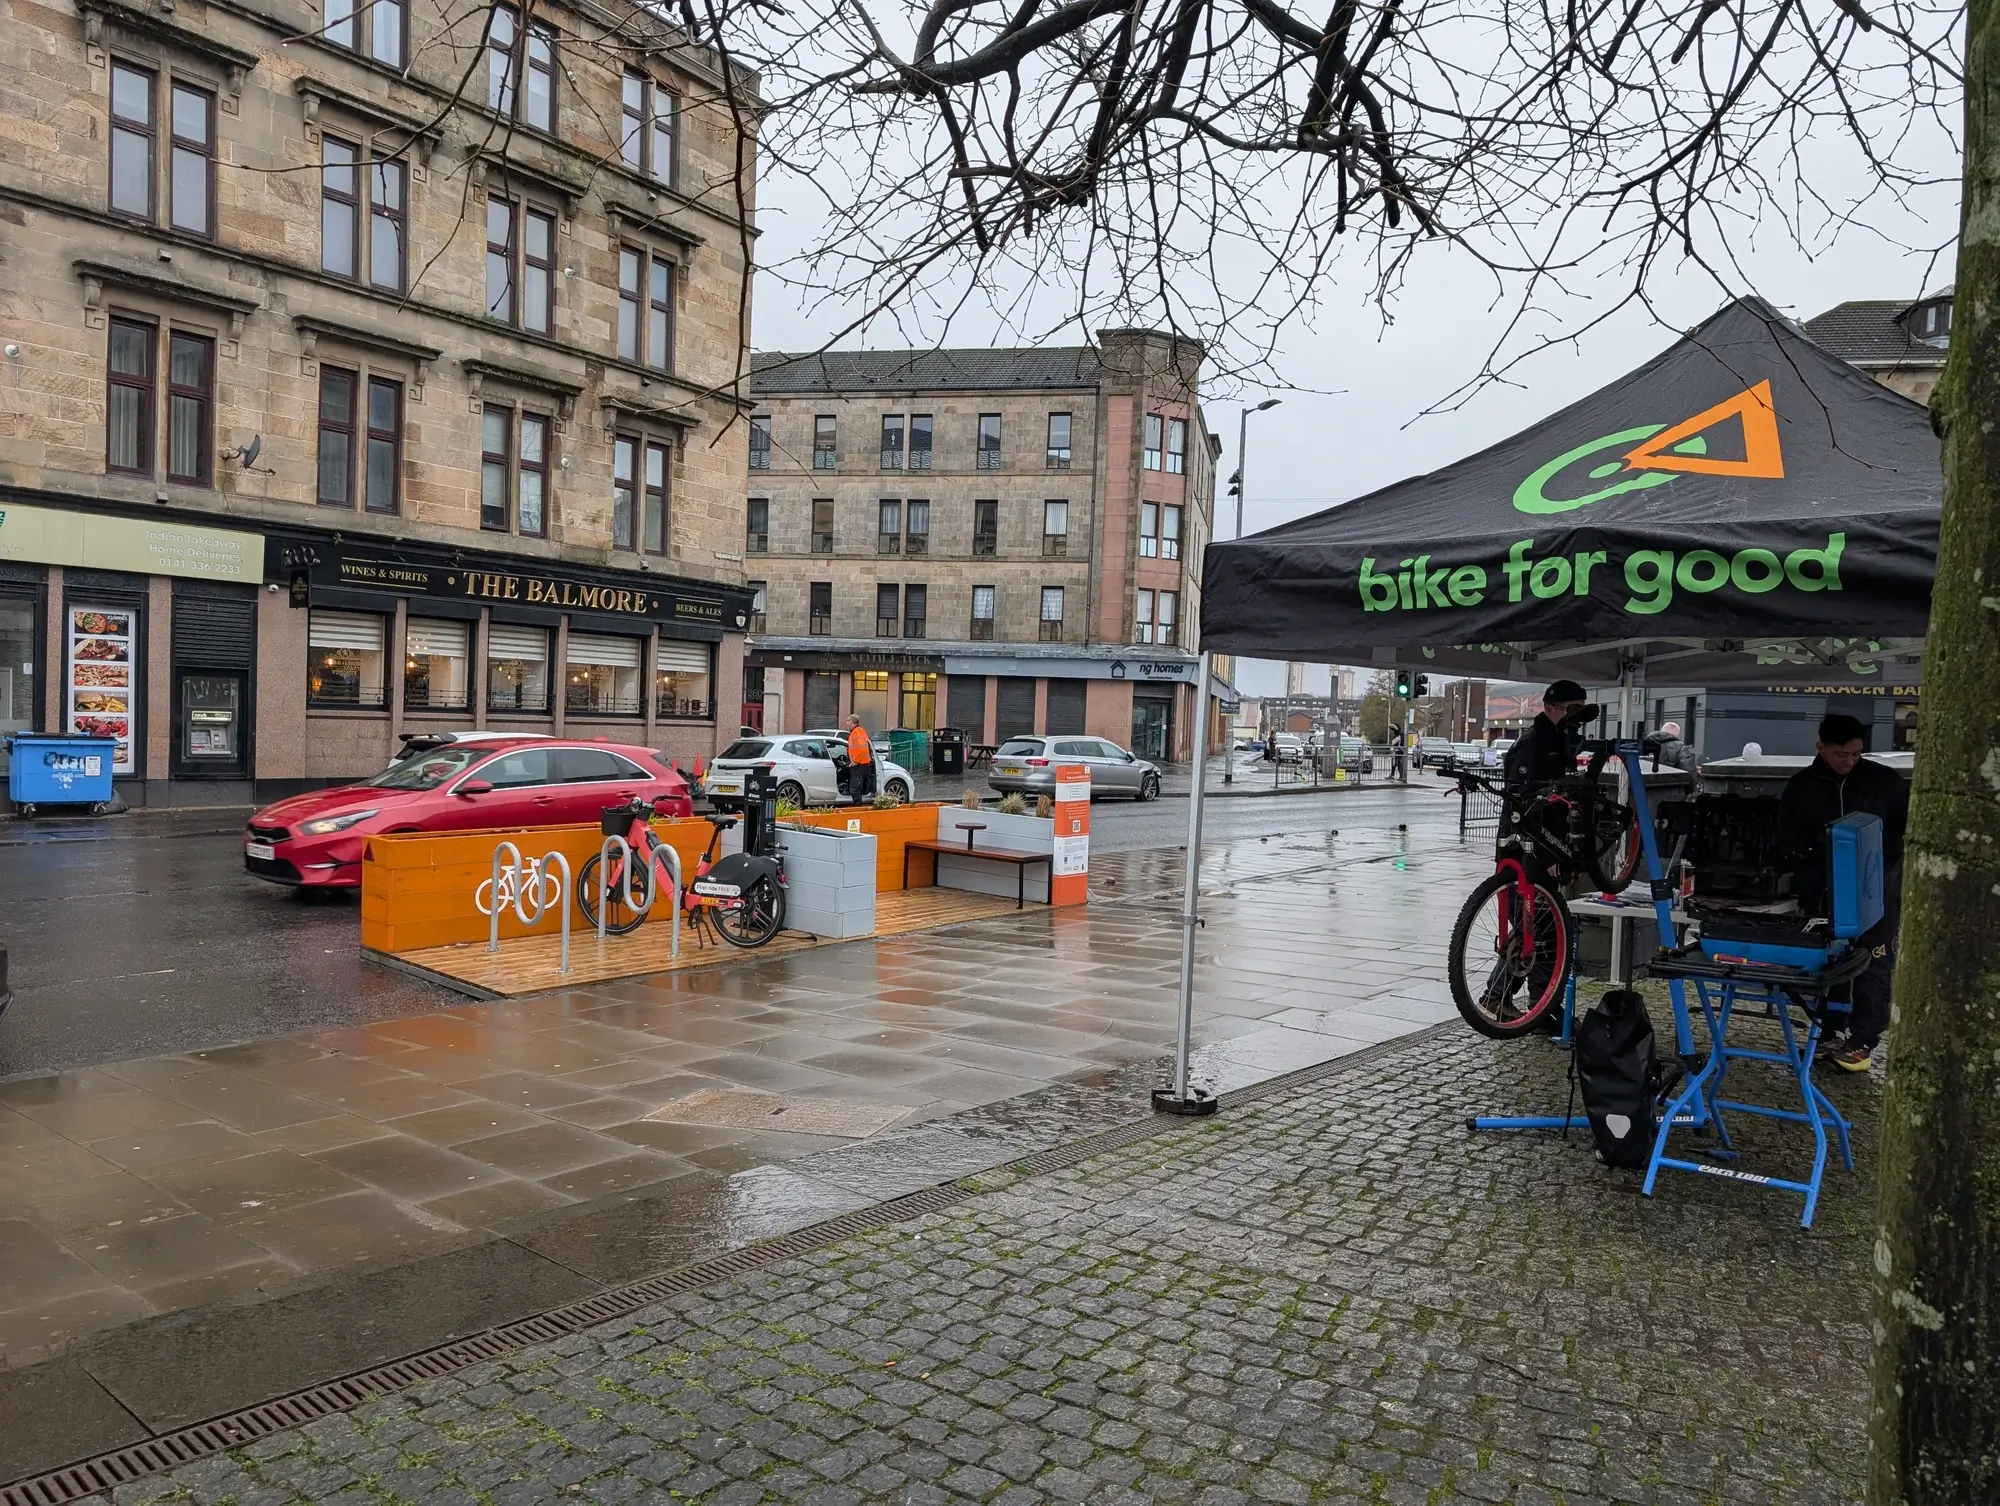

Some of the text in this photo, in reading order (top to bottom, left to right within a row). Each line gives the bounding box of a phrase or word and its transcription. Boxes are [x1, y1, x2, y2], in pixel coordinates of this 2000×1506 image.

[145, 529, 242, 551] Indian Takeaway
[149, 543, 241, 562] Home Deliveries
[159, 557, 241, 574] 0141 336 2233
[341, 564, 428, 583] WINES & SPIRITS
[1358, 531, 1846, 615] bike for good
[463, 572, 648, 614] THE BALMORE
[675, 603, 698, 614] BEERS
[705, 607, 722, 616] ALES
[850, 653, 886, 663] KEITH
[900, 655, 932, 665] TUCK
[1139, 661, 1184, 675] ng homes
[747, 688, 763, 698] 260
